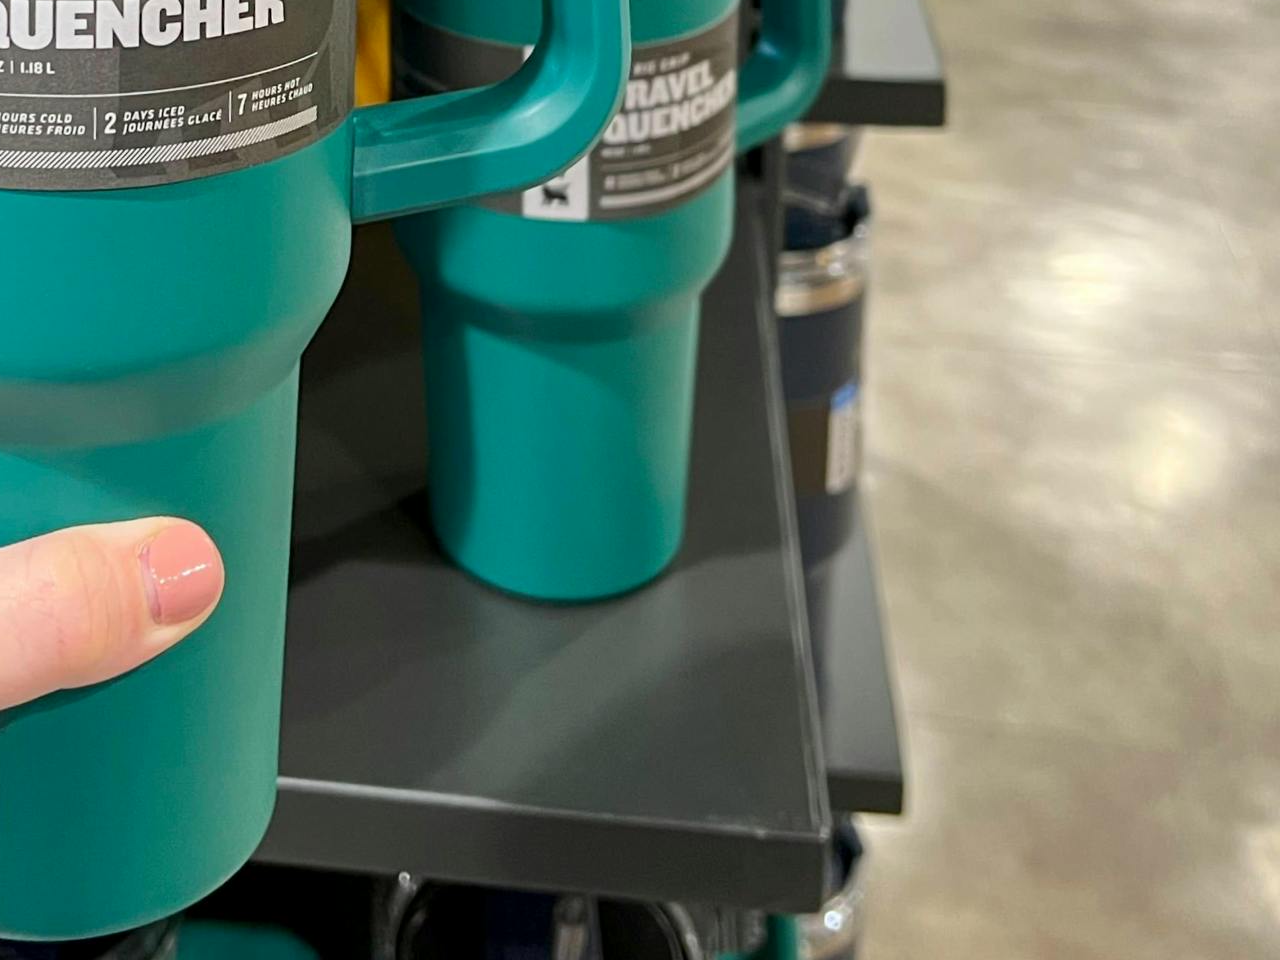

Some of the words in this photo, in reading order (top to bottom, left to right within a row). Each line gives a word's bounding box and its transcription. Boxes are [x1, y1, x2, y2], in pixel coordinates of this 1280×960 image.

[20, 61, 43, 74] 1.18
[46, 62, 55, 74] L
[251, 83, 283, 100] HOURS
[284, 77, 301, 90] HOT
[251, 93, 286, 112] HEURES
[288, 82, 313, 101] CHAUD
[123, 109, 155, 122] DAYS
[158, 105, 185, 118] ICED
[237, 93, 248, 115] 7
[40, 113, 73, 124] COLD
[104, 112, 117, 134] 2
[46, 125, 86, 135] FROID
